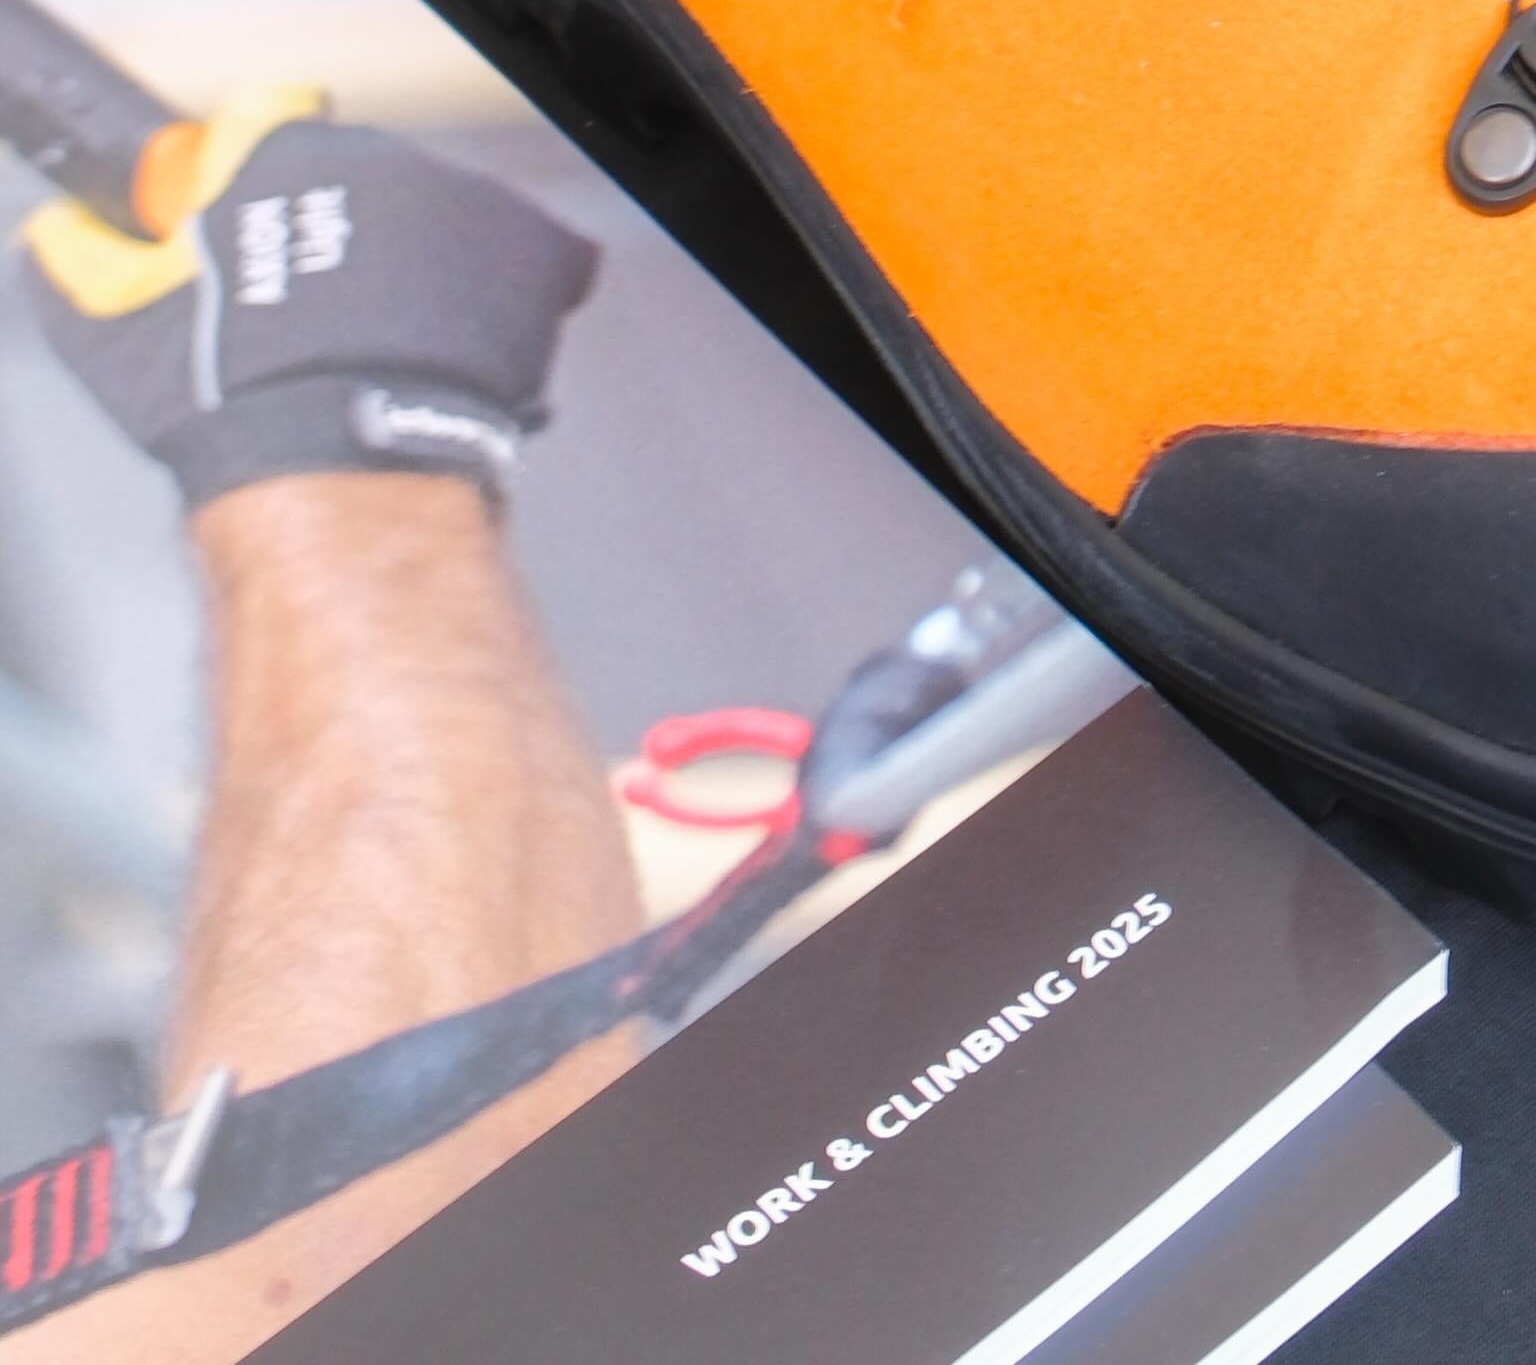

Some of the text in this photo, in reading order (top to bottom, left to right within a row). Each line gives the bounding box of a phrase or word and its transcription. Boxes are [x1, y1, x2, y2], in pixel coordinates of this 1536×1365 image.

[680, 892, 1173, 1277] WORK & CLIMBING 2025
